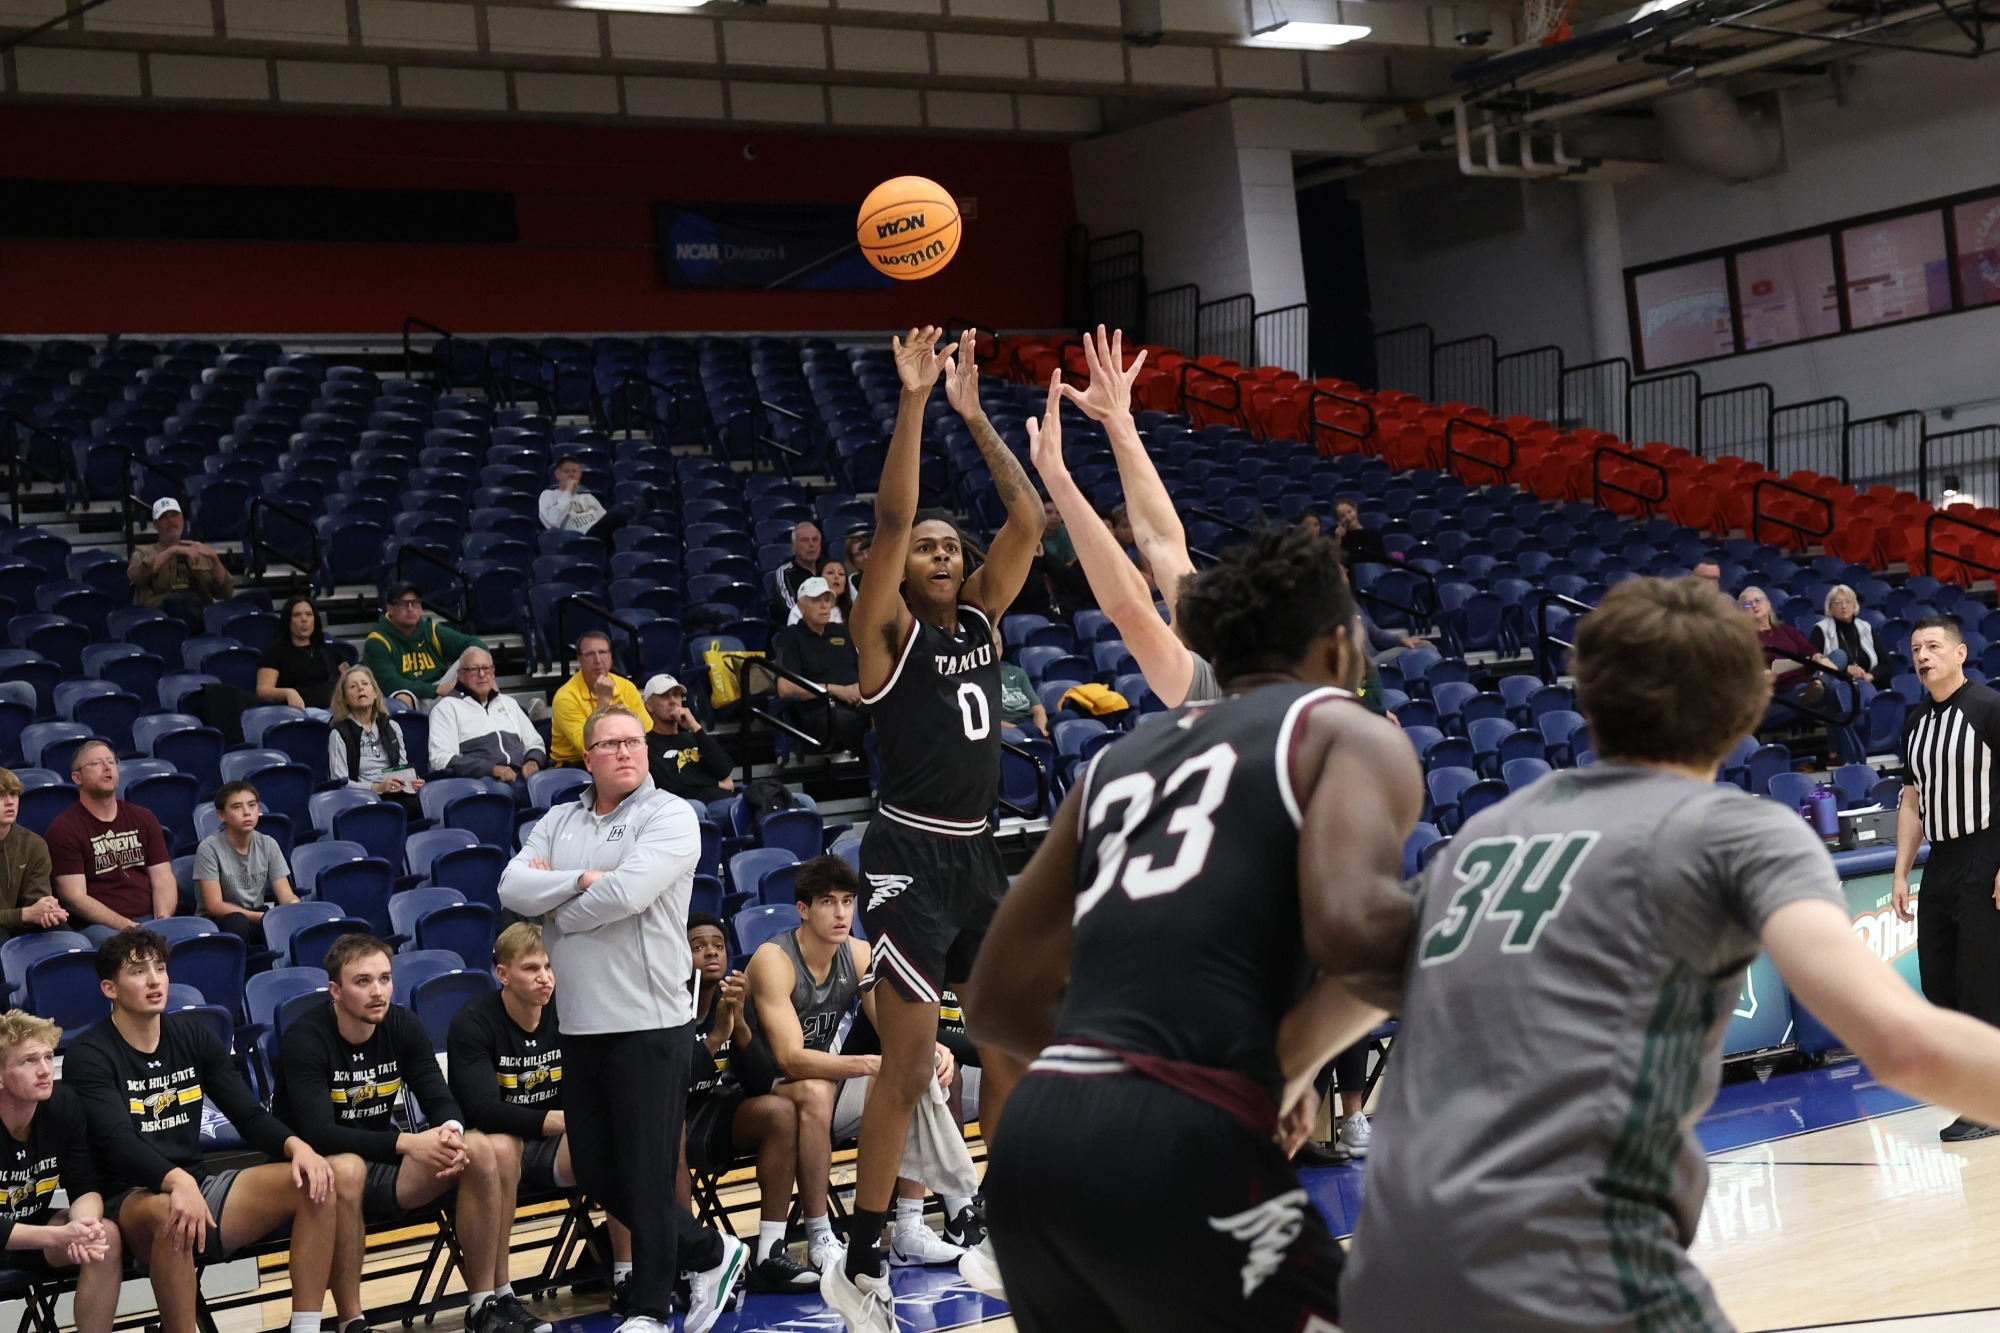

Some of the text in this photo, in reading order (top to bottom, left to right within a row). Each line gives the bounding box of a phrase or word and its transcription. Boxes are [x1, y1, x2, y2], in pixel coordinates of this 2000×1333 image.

[877, 213, 925, 239] NCAA
[676, 244, 719, 260] NCAA
[724, 245, 775, 260] Division
[877, 240, 946, 267] Wilson
[402, 652, 436, 673] BHSU
[956, 682, 990, 741] 0
[1072, 742, 1238, 928] 33
[1418, 830, 1602, 968] 34
[802, 1010, 838, 1047] 24
